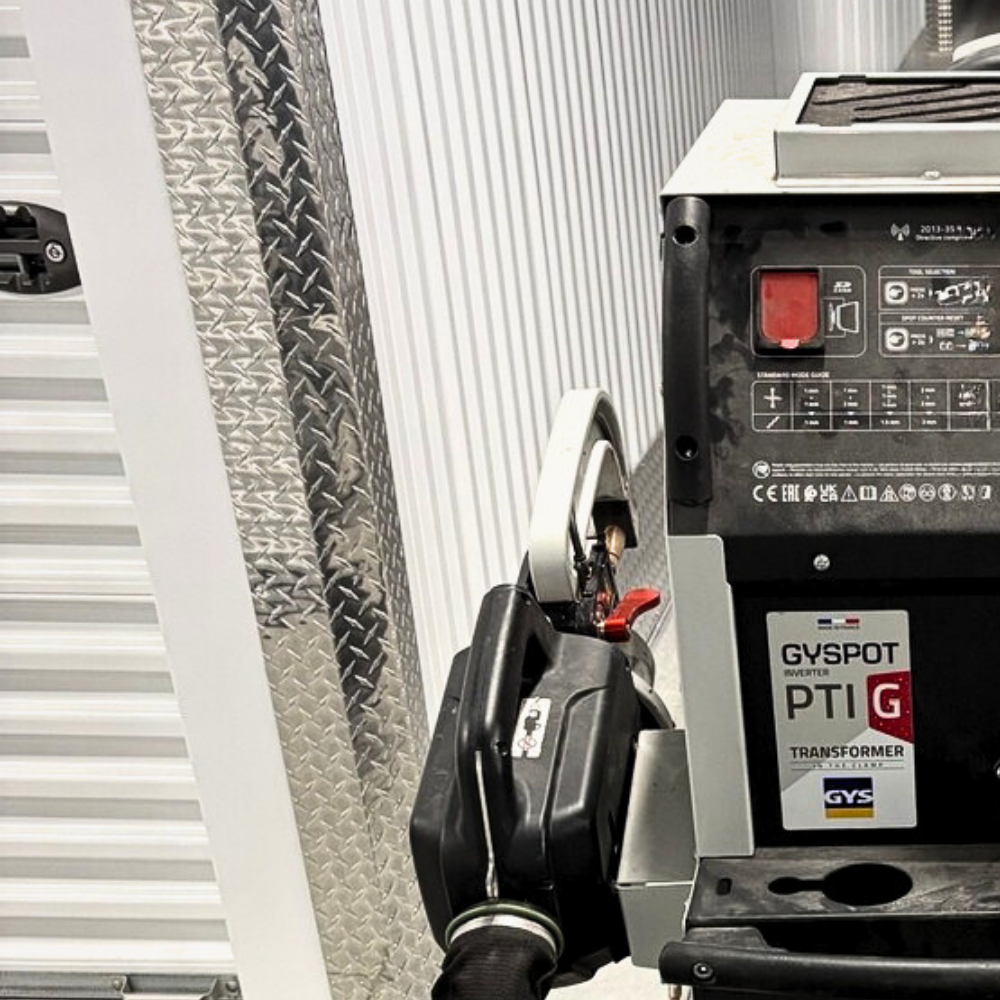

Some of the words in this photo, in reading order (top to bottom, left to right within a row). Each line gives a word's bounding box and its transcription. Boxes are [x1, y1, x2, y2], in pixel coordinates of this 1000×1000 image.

[782, 642, 899, 665] GYSPOT
[784, 668, 829, 677] INVERTER
[785, 684, 855, 719] PTI
[872, 683, 901, 719] G
[790, 745, 904, 758] TRANSFORMER
[824, 790, 874, 804] GYS
